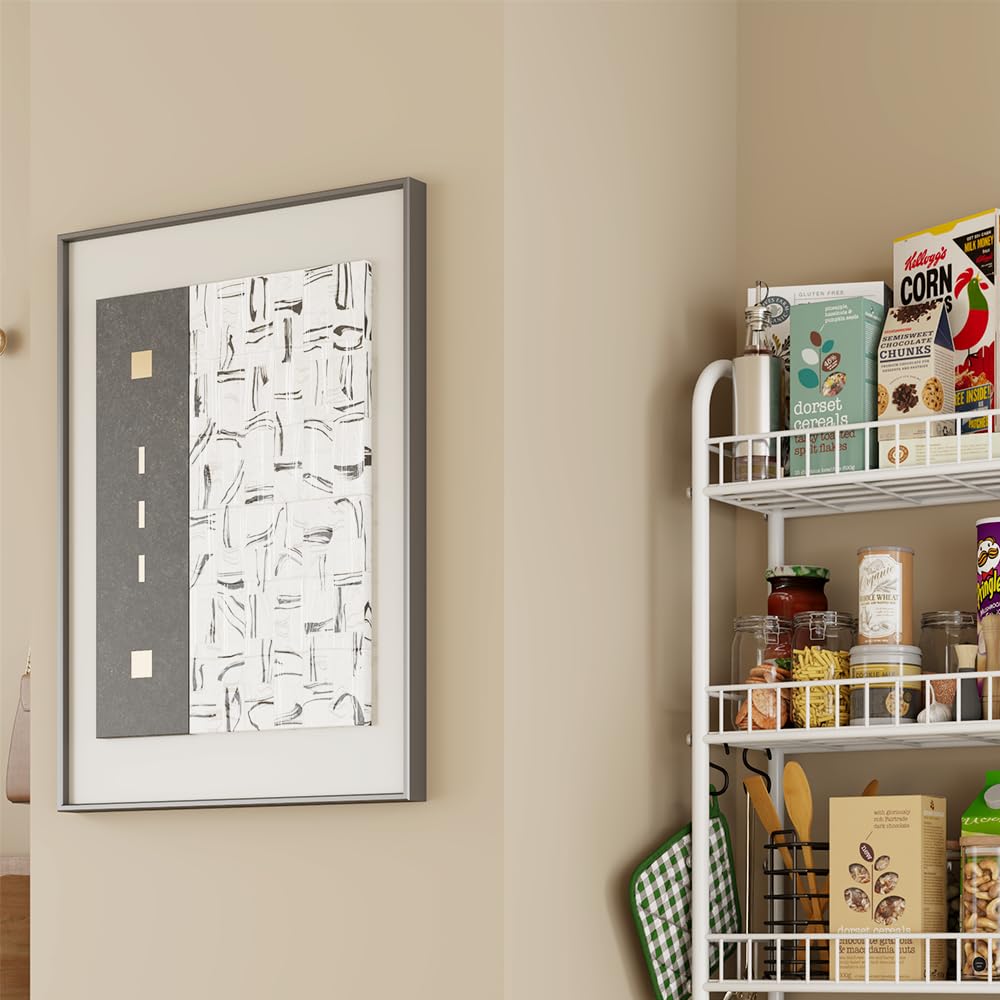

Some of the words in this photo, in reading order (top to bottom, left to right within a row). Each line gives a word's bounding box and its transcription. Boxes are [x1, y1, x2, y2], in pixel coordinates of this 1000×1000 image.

[904, 246, 947, 271] Kellogg's
[900, 264, 952, 305] CORN
[882, 330, 934, 342] SEMISWEET
[880, 338, 933, 349] CHOCOLATE
[880, 345, 931, 359] CHUNKS
[794, 398, 842, 415] dorset
[794, 413, 848, 430] cereals
[821, 430, 856, 440] toated
[794, 444, 818, 456] splt
